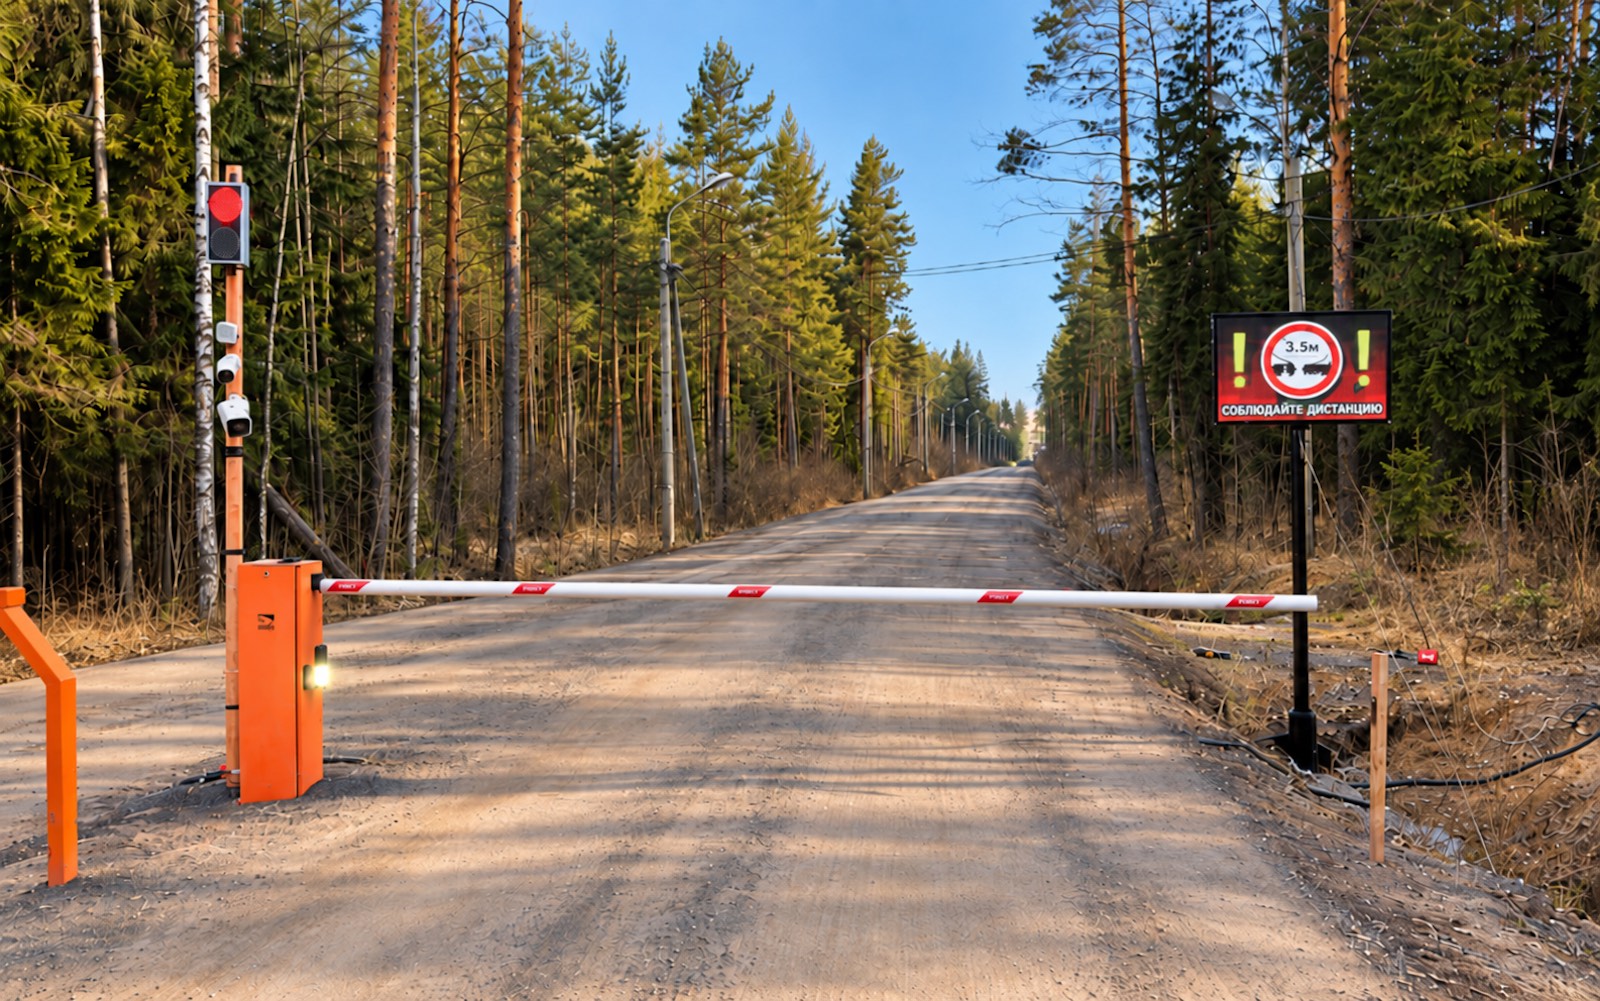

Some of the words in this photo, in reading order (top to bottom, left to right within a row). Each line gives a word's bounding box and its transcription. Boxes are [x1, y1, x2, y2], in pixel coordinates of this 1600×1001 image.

[1233, 332, 1246, 388] !
[1357, 330, 1371, 387] !
[1221, 402, 1304, 417] СОБЛЮДАЙТЕ
[1306, 403, 1383, 417] ДИСТАНЦИЮ
